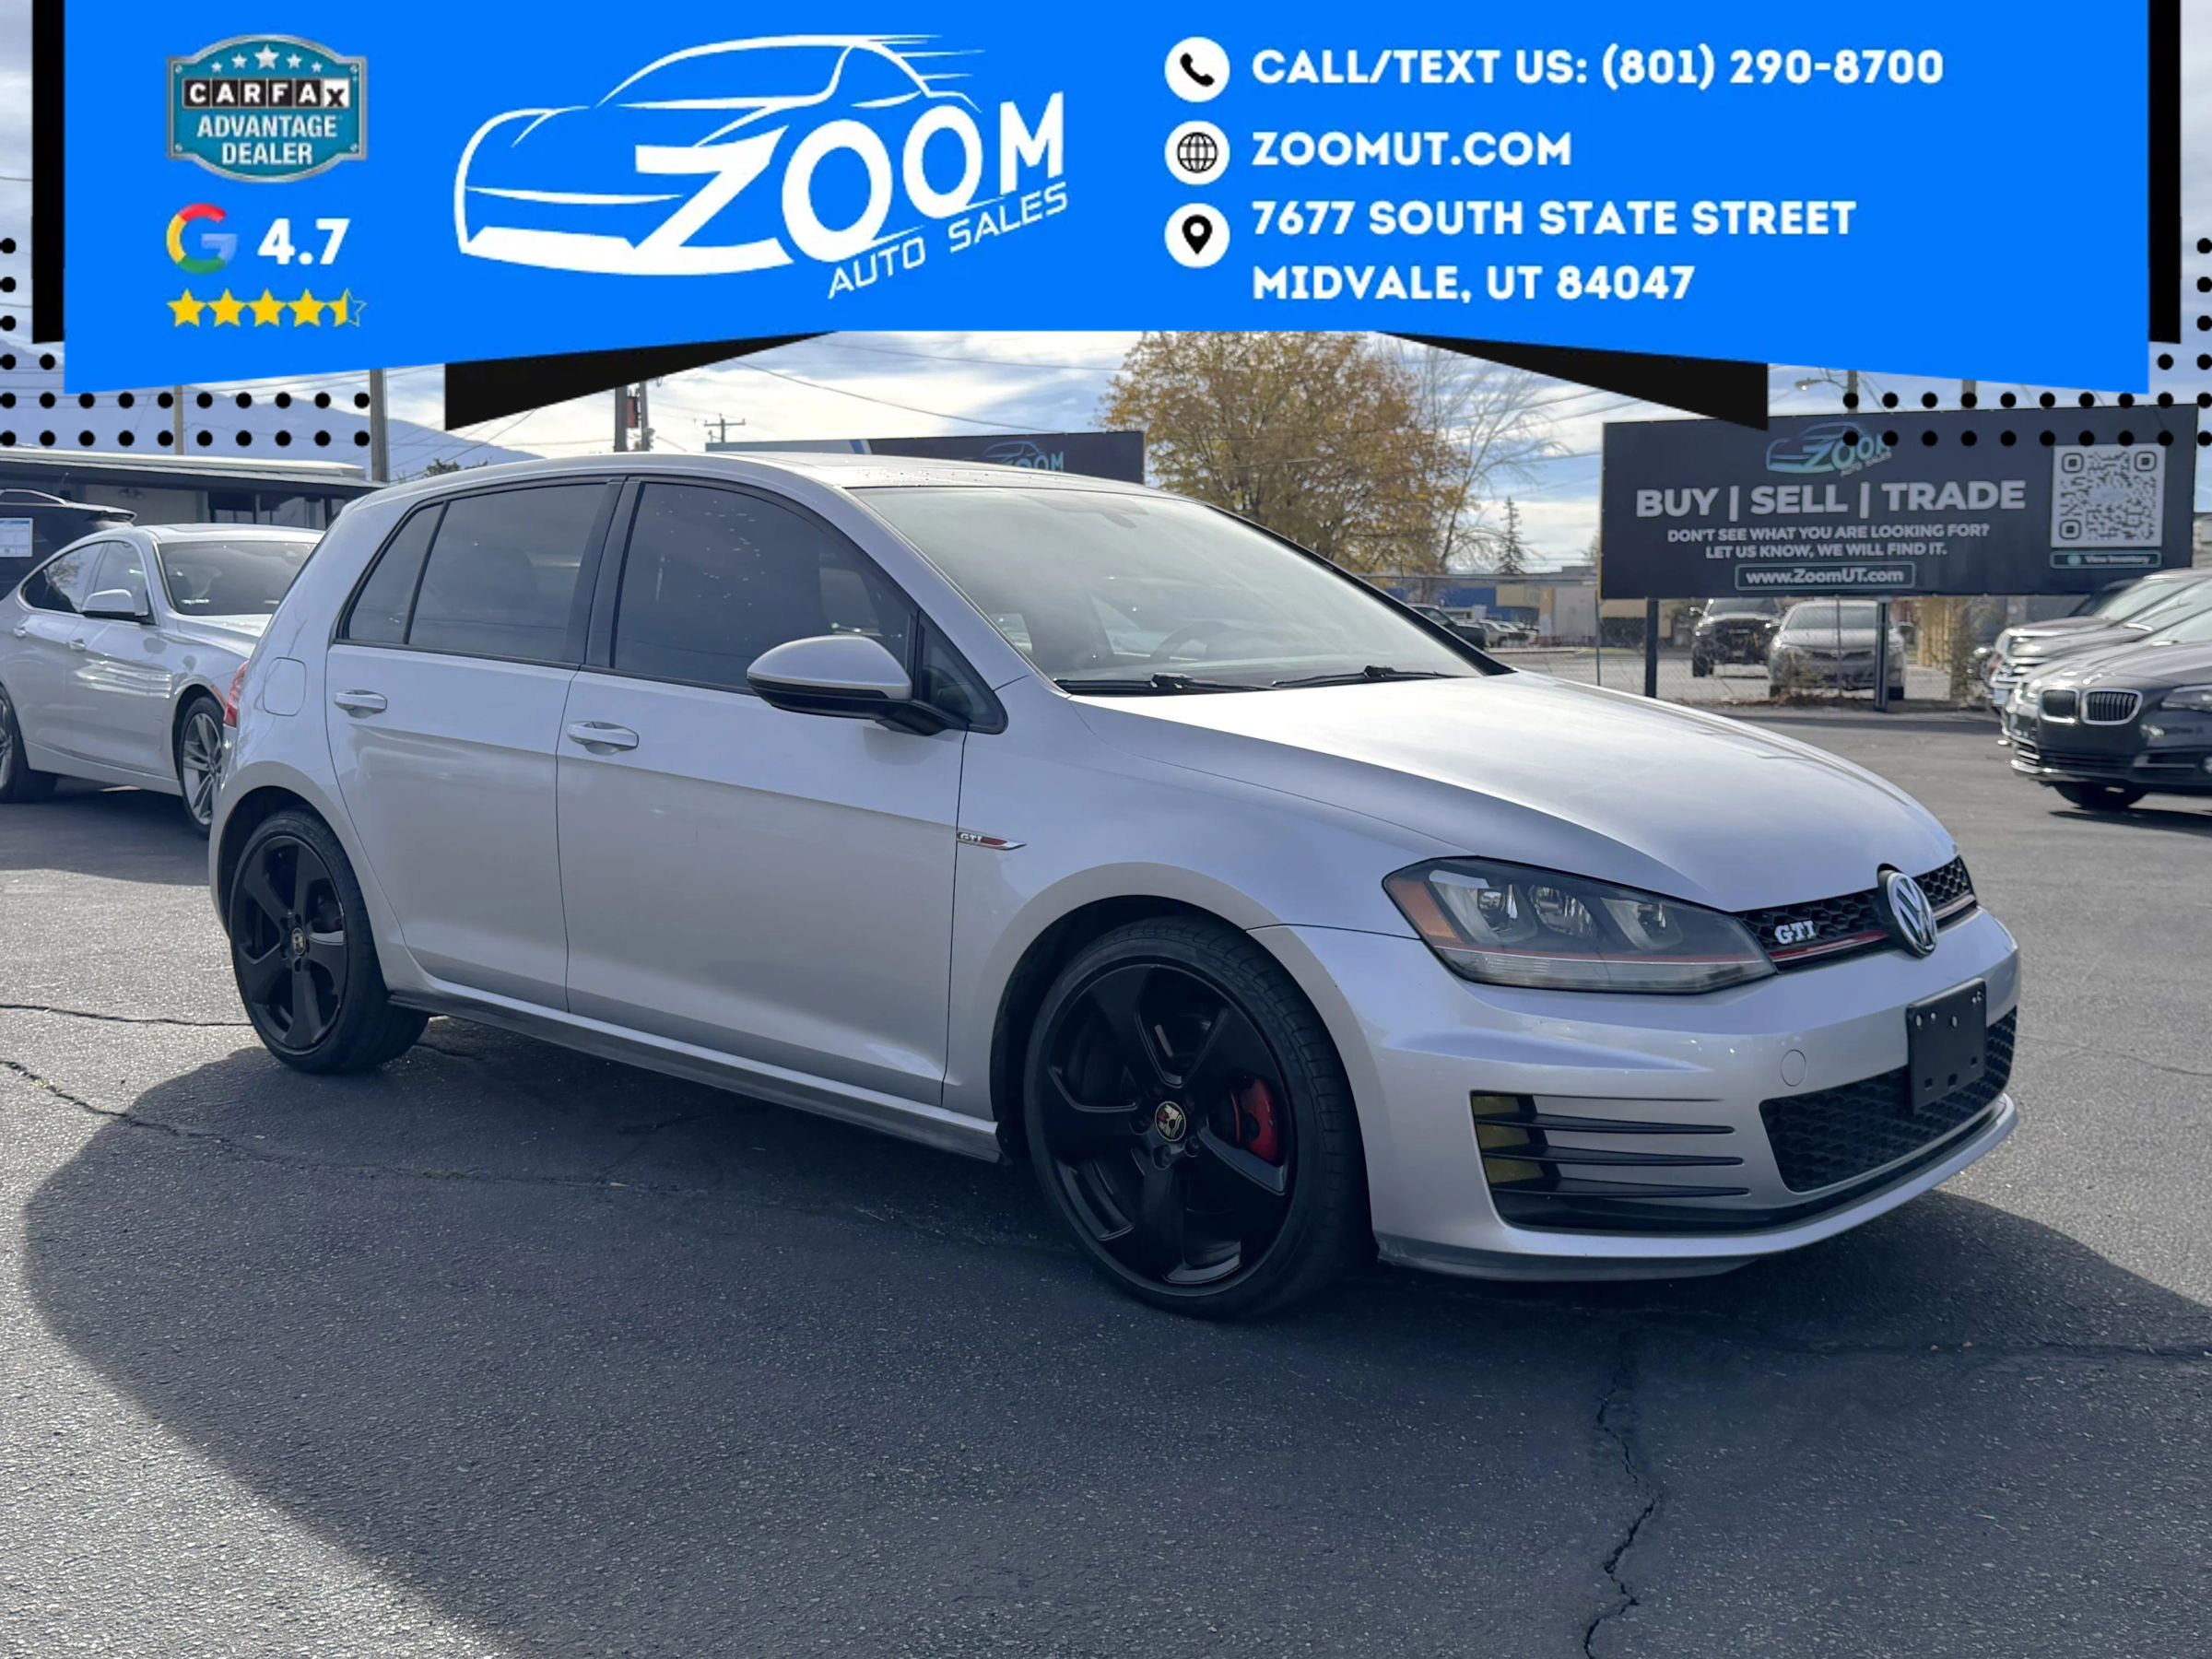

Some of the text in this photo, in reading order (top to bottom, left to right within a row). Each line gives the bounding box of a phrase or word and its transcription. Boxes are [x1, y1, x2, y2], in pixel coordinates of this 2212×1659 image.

[1636, 488, 1720, 518] BUY
[1750, 484, 1848, 515] SELL
[1881, 479, 2026, 512] TRADE
[1667, 523, 1990, 542] DON'T SEE WHAT YOU ARE LOOKING FOR?
[1705, 541, 1947, 559] LET US KNOW, WE WILL FIND IT.
[1746, 567, 1905, 584] www.ZoomUT.com
[1774, 920, 1817, 945] GTI
